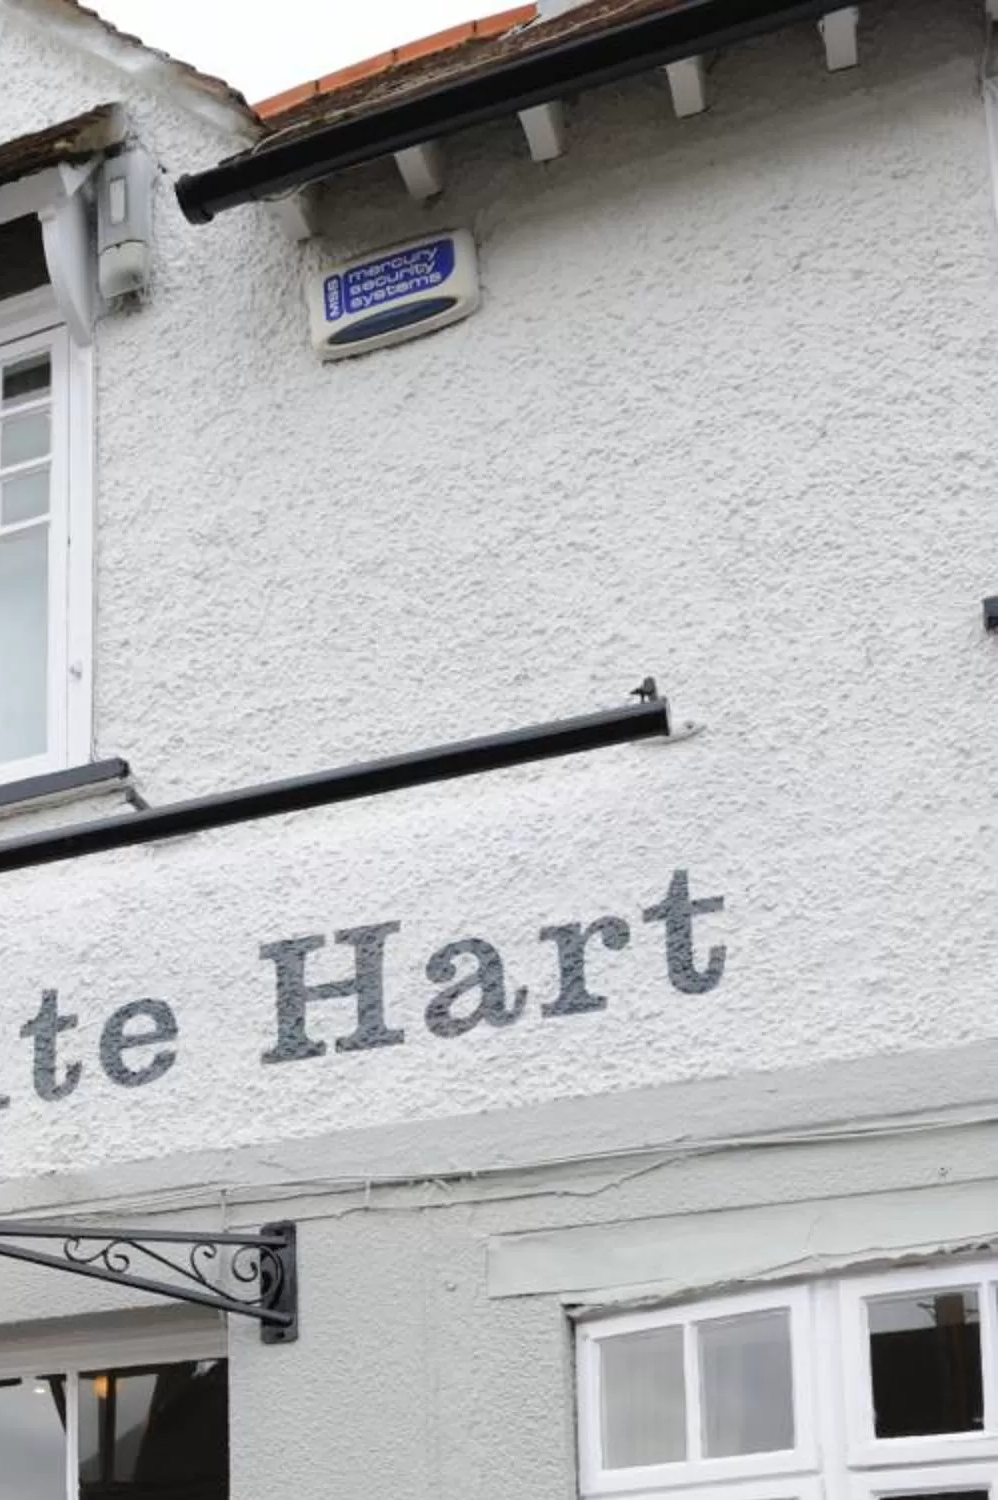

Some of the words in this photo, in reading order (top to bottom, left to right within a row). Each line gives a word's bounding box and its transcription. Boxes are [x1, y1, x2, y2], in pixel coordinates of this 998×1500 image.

[348, 247, 438, 283] mercury
[349, 260, 435, 296] security
[349, 272, 442, 309] systems
[258, 868, 727, 1065] Hart
